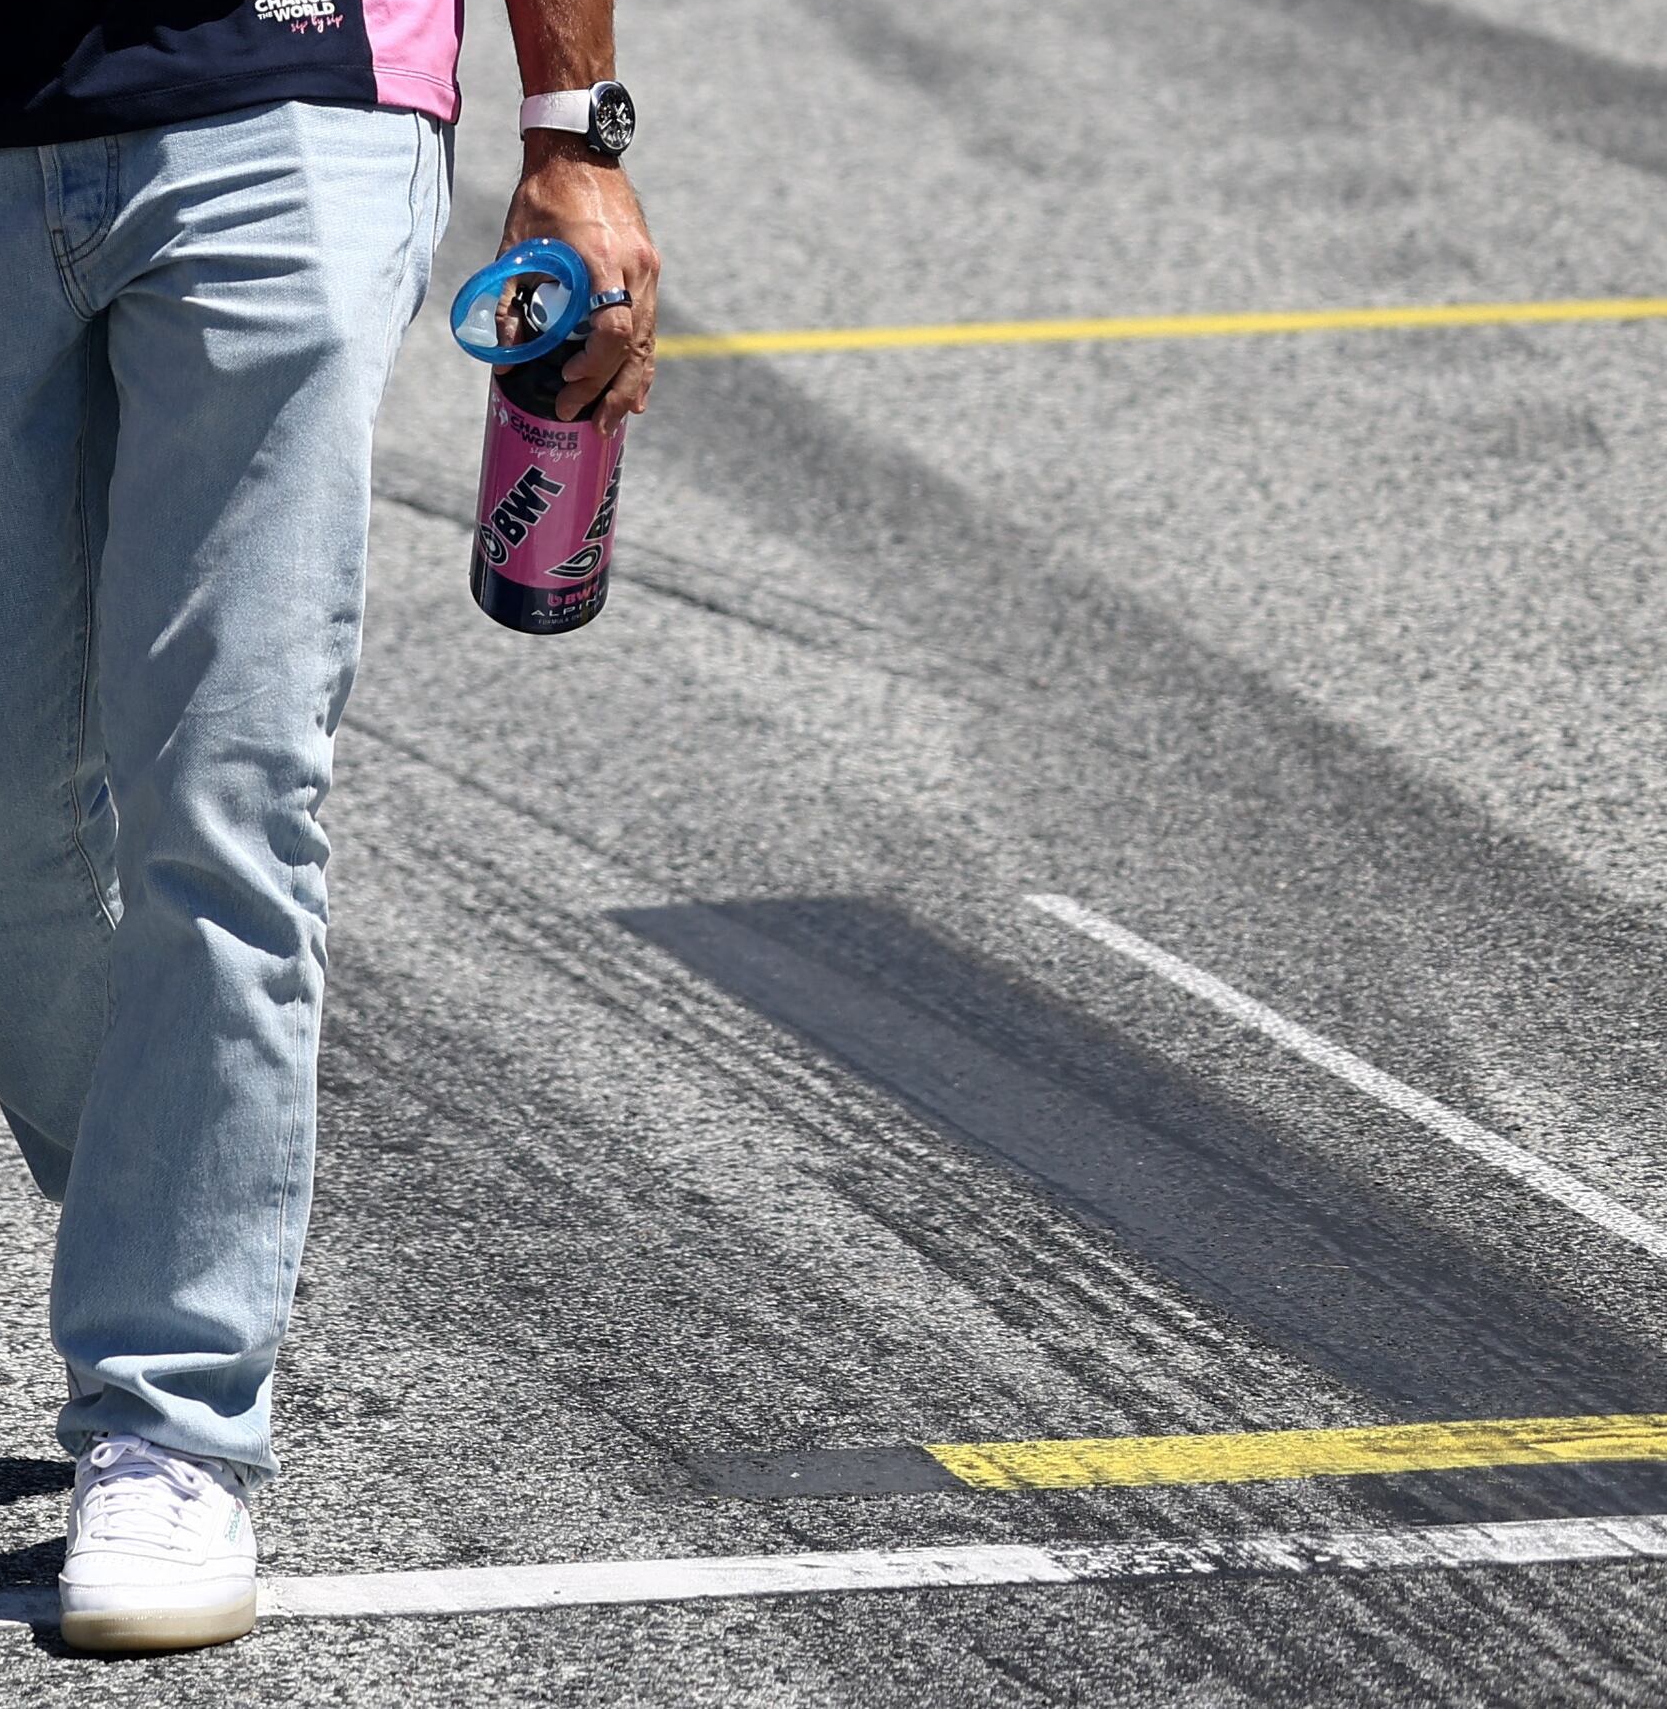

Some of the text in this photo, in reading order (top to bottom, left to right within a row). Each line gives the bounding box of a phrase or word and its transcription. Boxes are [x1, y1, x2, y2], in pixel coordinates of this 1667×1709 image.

[273, 2, 335, 22] WORLD
[510, 414, 579, 441] CHANGE
[522, 432, 578, 450] WORLD
[489, 464, 566, 549] BWT
